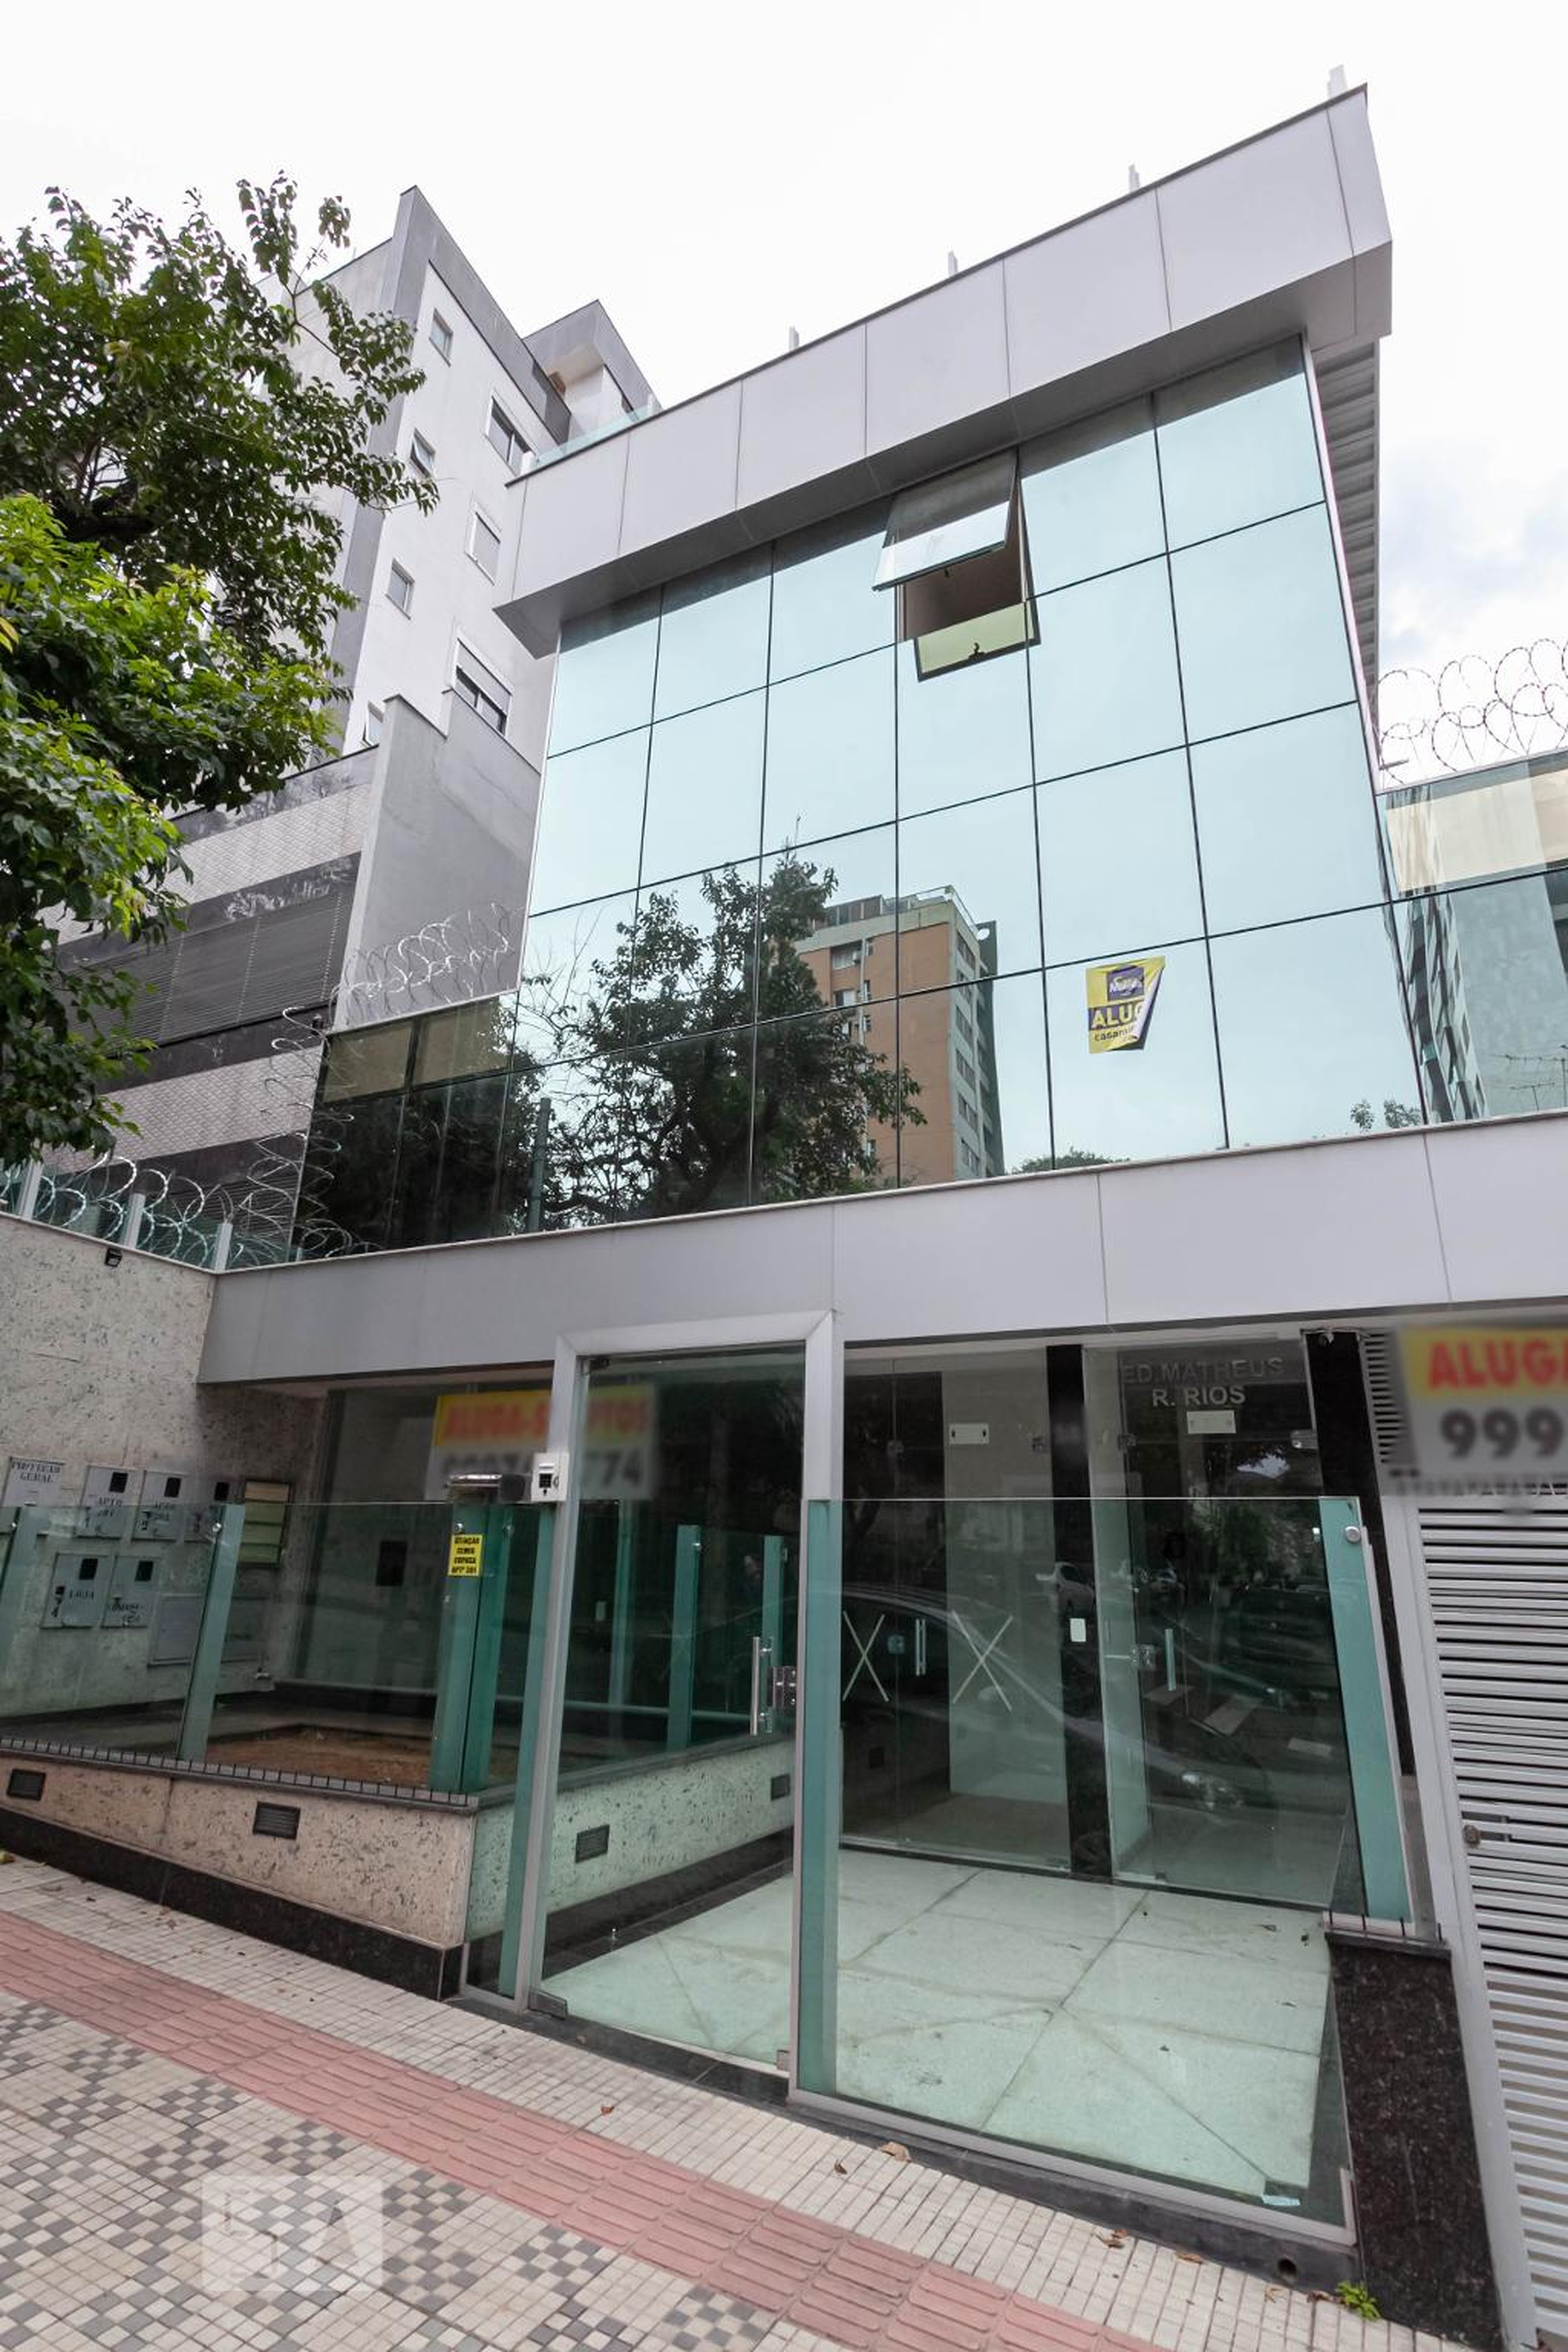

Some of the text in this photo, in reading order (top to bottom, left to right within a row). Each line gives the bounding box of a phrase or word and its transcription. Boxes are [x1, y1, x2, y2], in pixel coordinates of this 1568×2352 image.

[1123, 1357, 1284, 1383] ED MATHEUS
[1428, 1338, 1568, 1390] ALUG
[1152, 1386, 1246, 1407] R. RIOS
